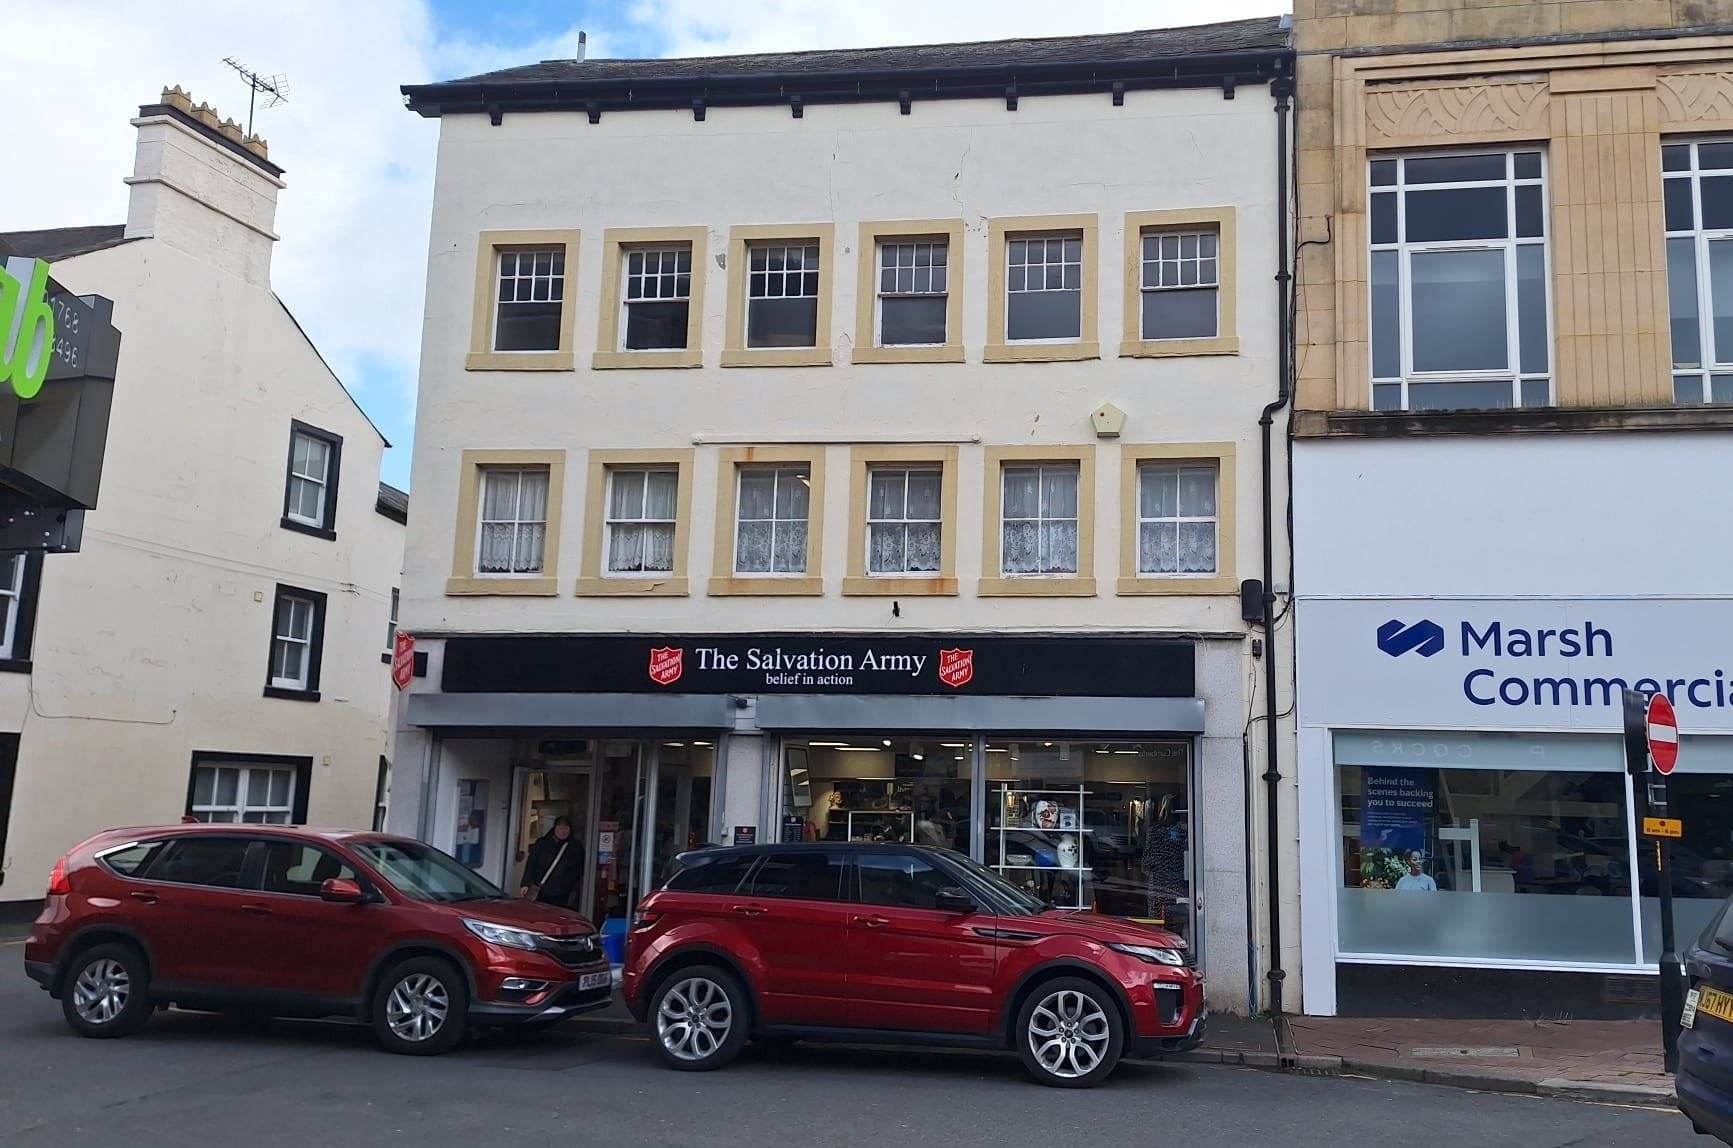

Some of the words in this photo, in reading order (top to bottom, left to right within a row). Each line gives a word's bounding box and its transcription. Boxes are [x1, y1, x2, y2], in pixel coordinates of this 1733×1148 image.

[44, 290, 80, 334] 1768
[1462, 621, 1612, 657] Marsh
[651, 654, 680, 674] SALVATION
[657, 651, 669, 662] THE
[696, 647, 739, 672] The
[746, 647, 854, 672] Salvation
[858, 648, 927, 678] Army
[947, 652, 959, 664] THE
[660, 664, 679, 681] ARMY
[941, 656, 970, 676] SALVATION
[951, 666, 969, 682] ARMY
[765, 672, 800, 687] belief
[803, 673, 814, 687] in
[816, 673, 853, 687] action
[1463, 669, 1733, 708] Commerci
[1368, 776, 1398, 786] Behind
[1400, 777, 1415, 786] the
[1368, 788, 1398, 797] scenes
[1400, 788, 1434, 800] backing
[1367, 799, 1384, 808] you
[1385, 799, 1395, 807] to
[1397, 799, 1433, 808] succeed
